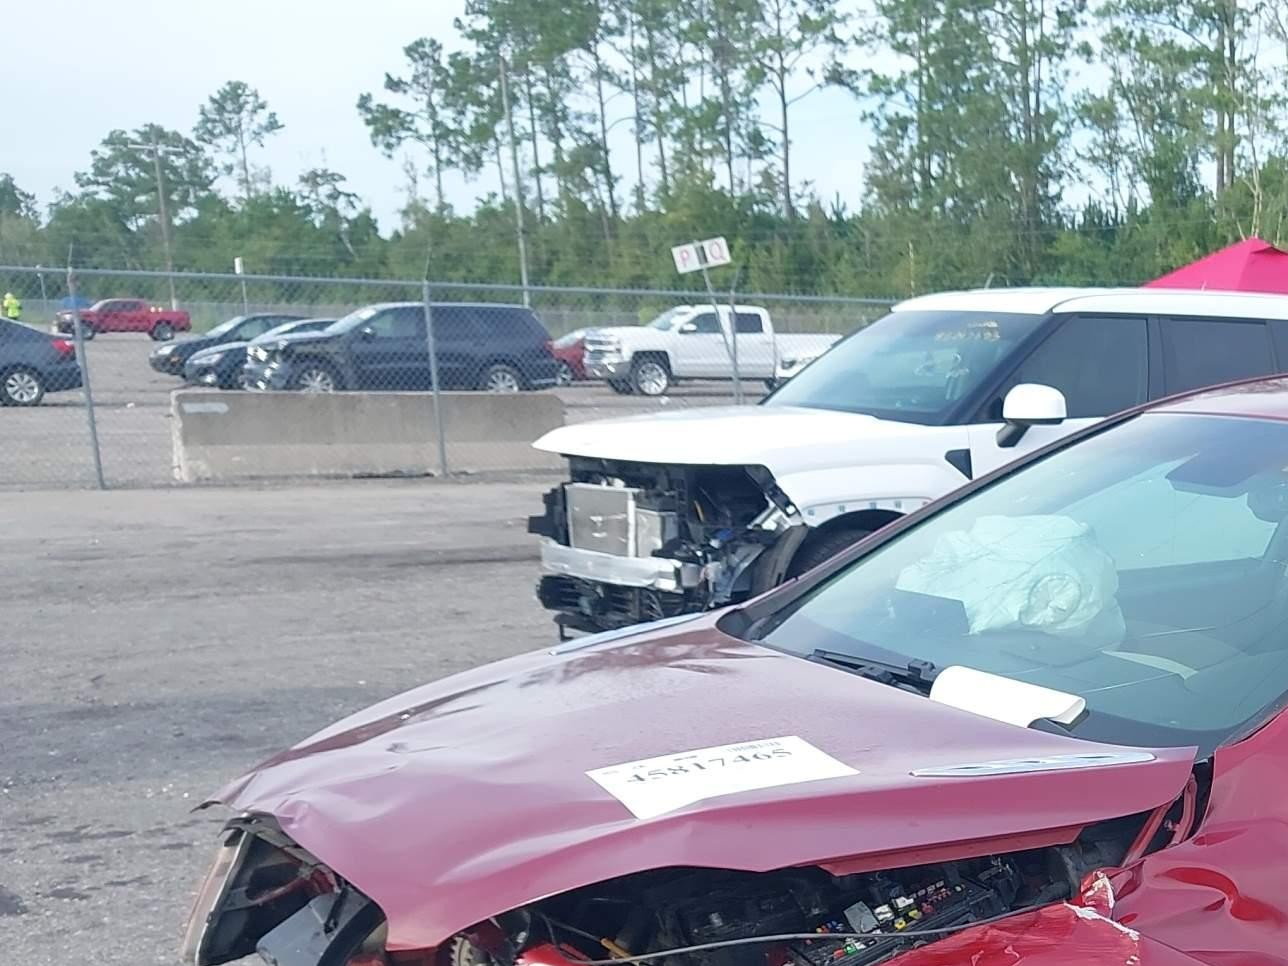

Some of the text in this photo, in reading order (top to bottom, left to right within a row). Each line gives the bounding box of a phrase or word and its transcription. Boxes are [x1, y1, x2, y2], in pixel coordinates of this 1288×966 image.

[679, 239, 728, 269] P Q
[626, 748, 793, 783] 45817465
